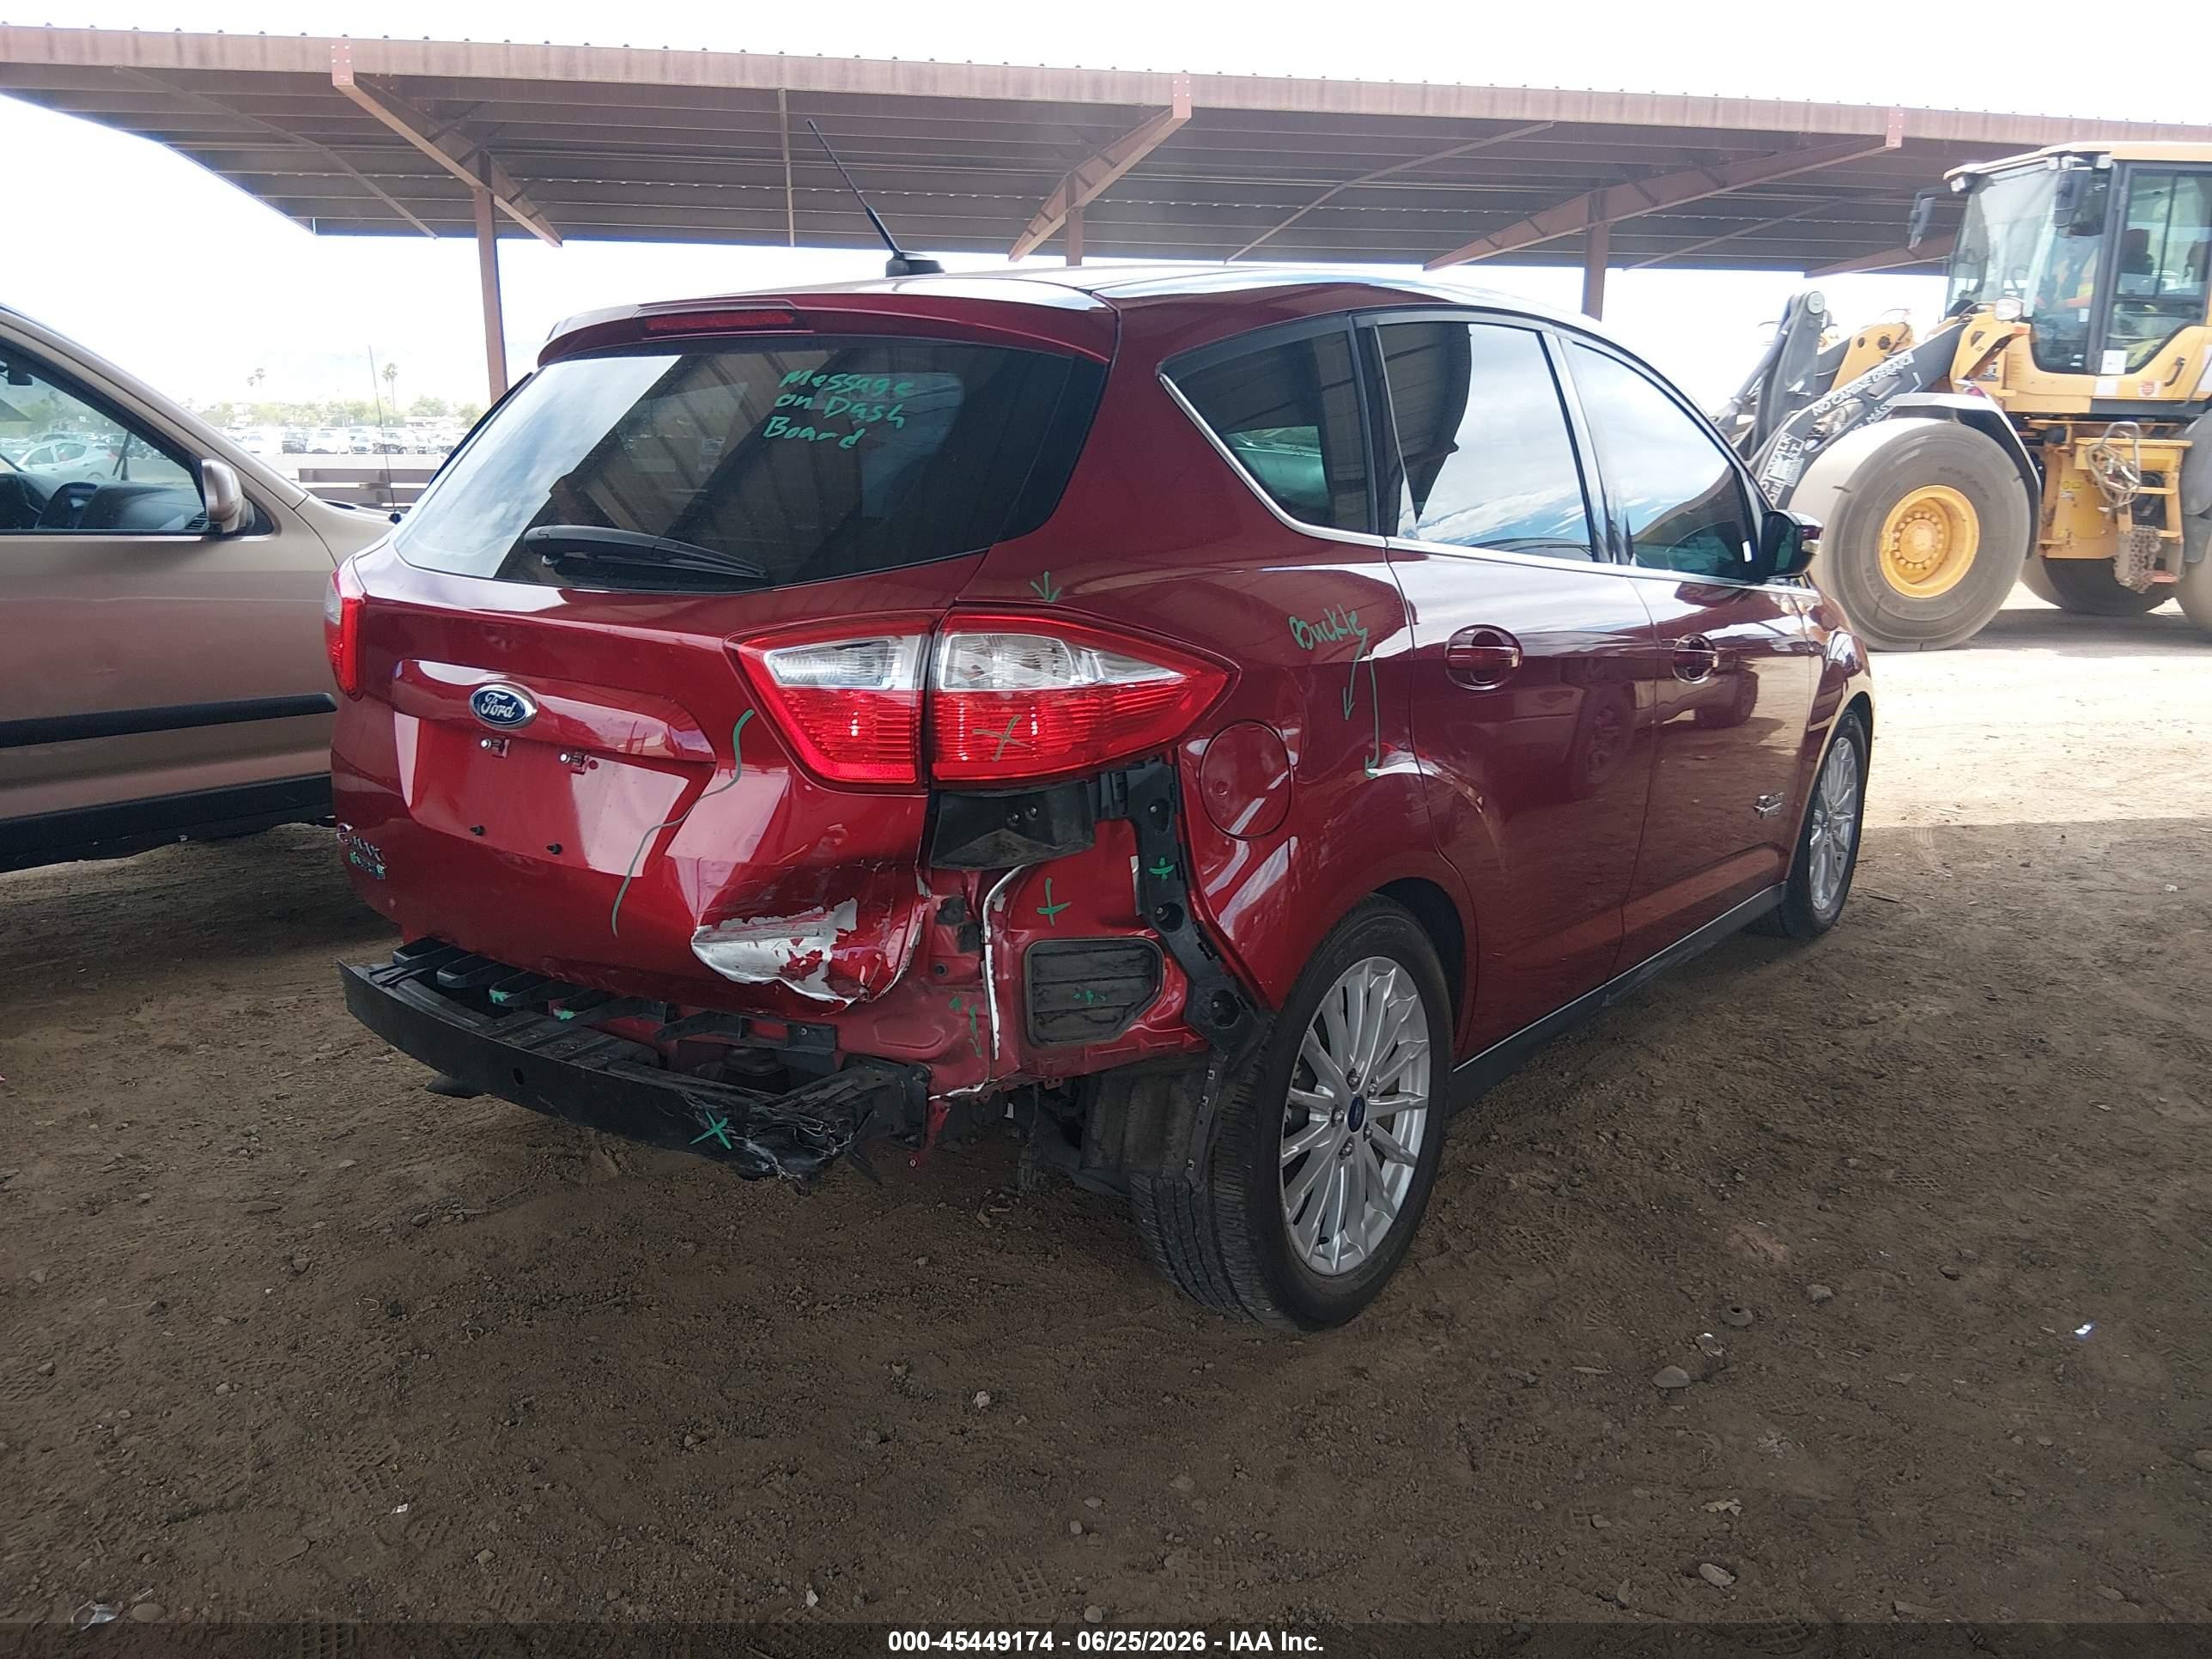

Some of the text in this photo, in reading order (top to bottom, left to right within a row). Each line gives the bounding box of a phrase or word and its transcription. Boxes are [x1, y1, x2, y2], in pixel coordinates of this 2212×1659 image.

[779, 370, 914, 397] Message
[775, 393, 905, 428] on Dash
[763, 416, 866, 449] Board
[1289, 604, 1368, 650] Buckle
[481, 692, 517, 719] Ford
